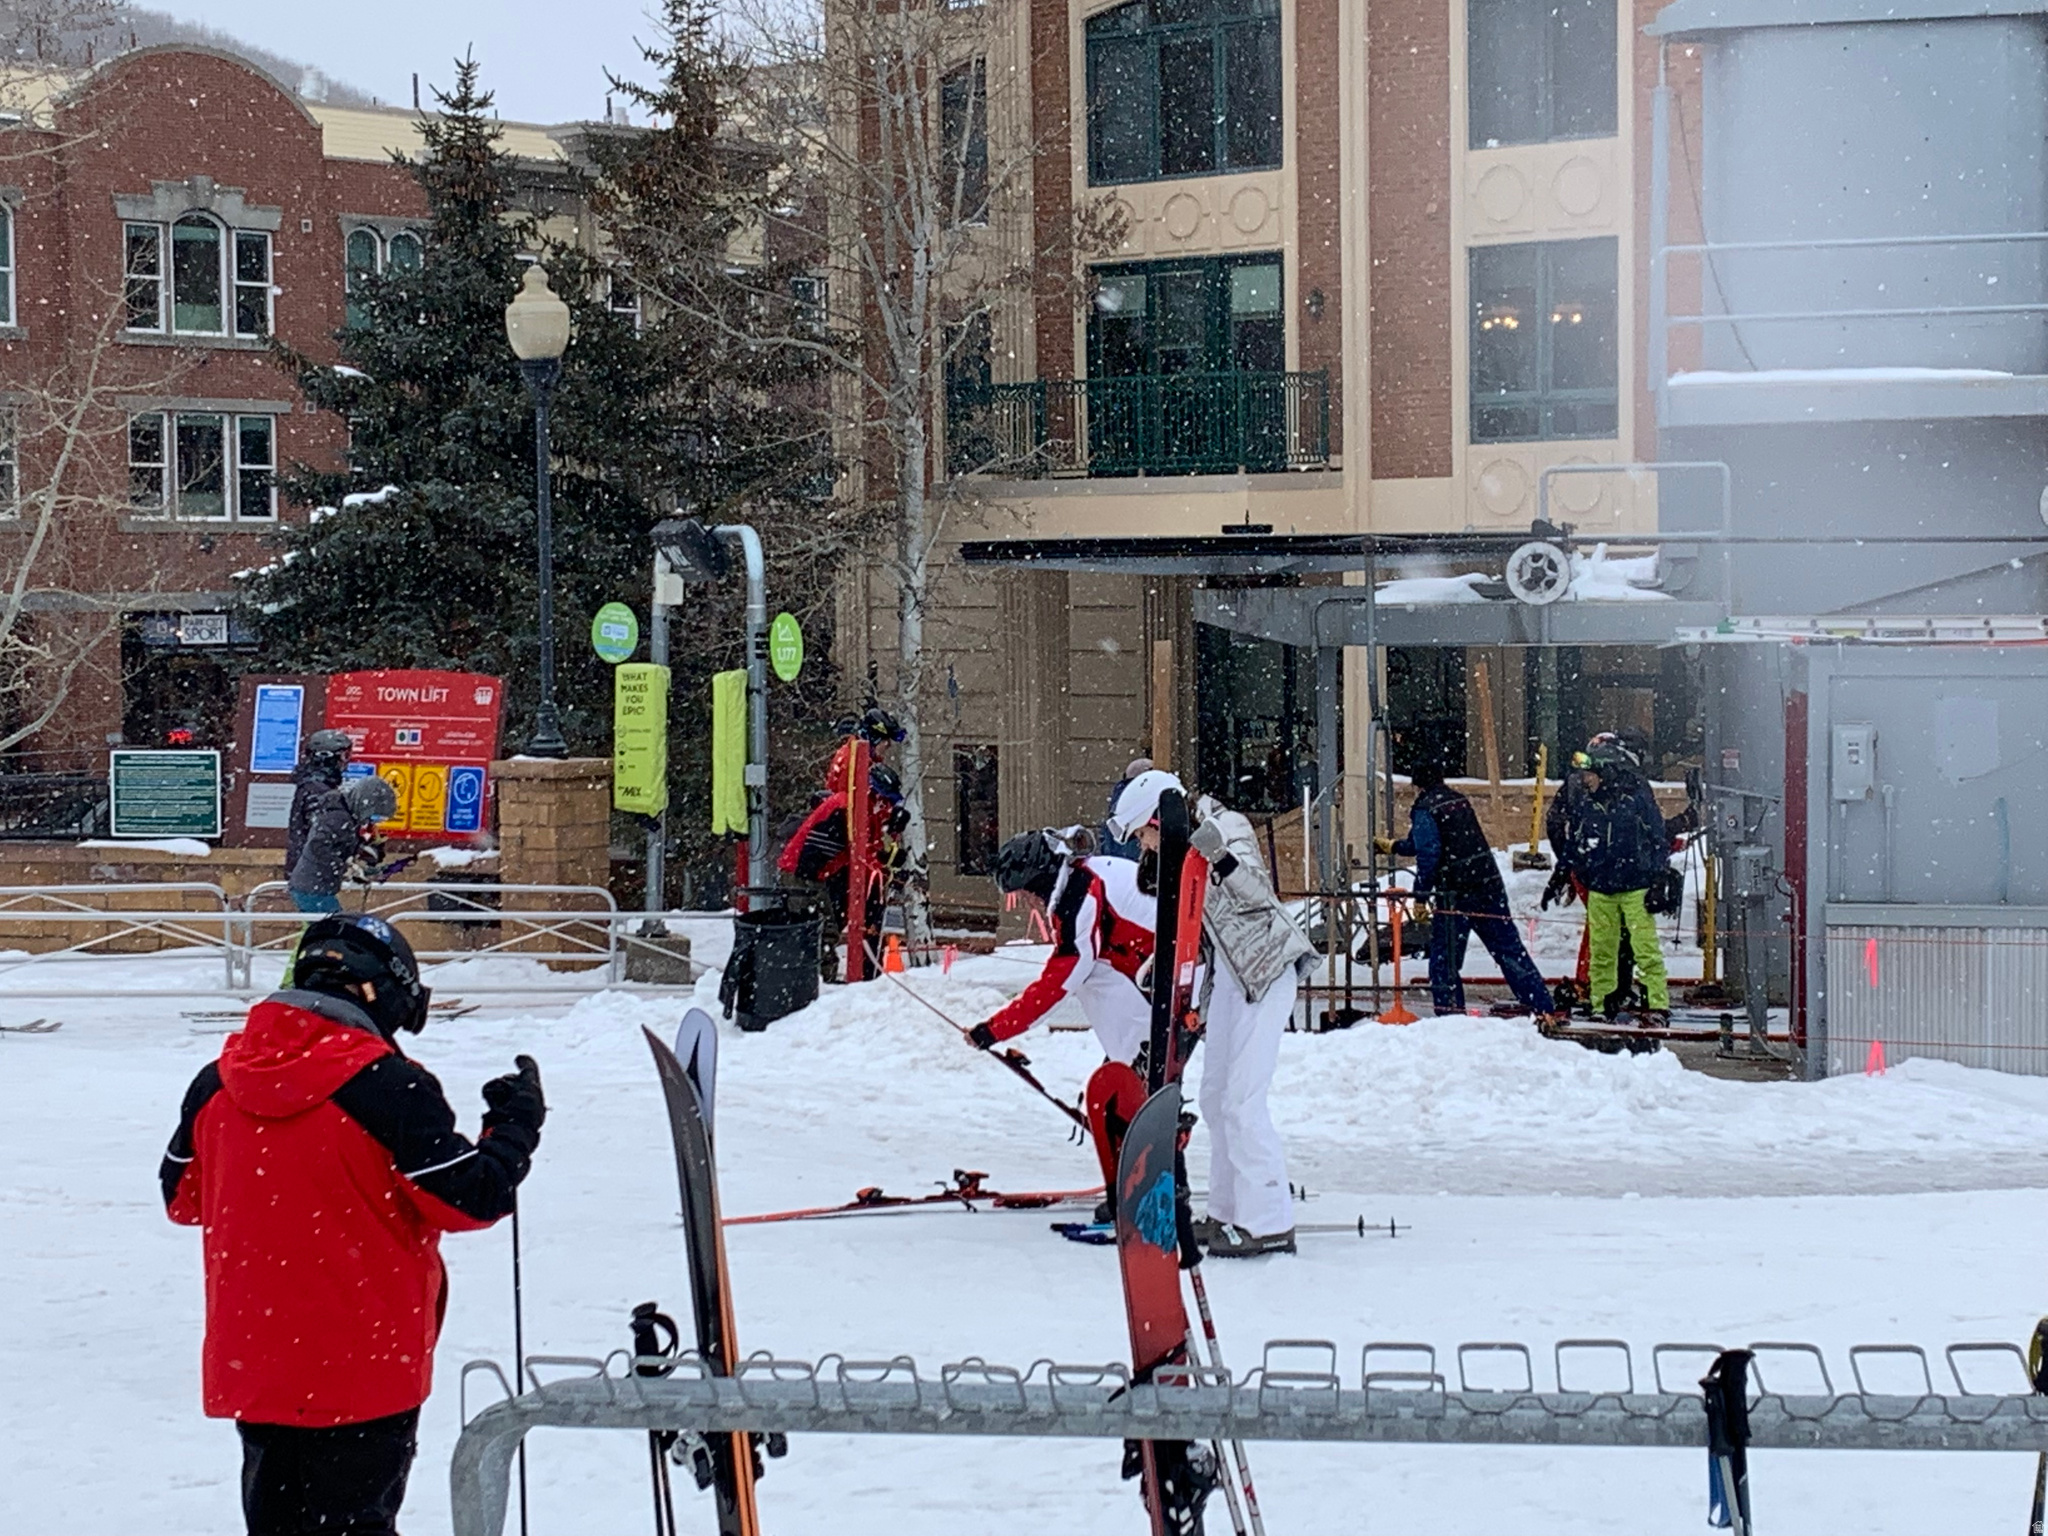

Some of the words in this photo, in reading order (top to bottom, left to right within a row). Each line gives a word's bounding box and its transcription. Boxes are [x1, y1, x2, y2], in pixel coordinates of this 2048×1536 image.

[206, 617, 224, 627] CITY
[184, 628, 223, 641] SPORT
[622, 672, 647, 681] WHAT
[620, 684, 648, 693] MAKES
[377, 687, 419, 702] TOWN
[421, 687, 450, 703] LIFT
[625, 695, 644, 704] YOU
[622, 706, 646, 716] EPIC?
